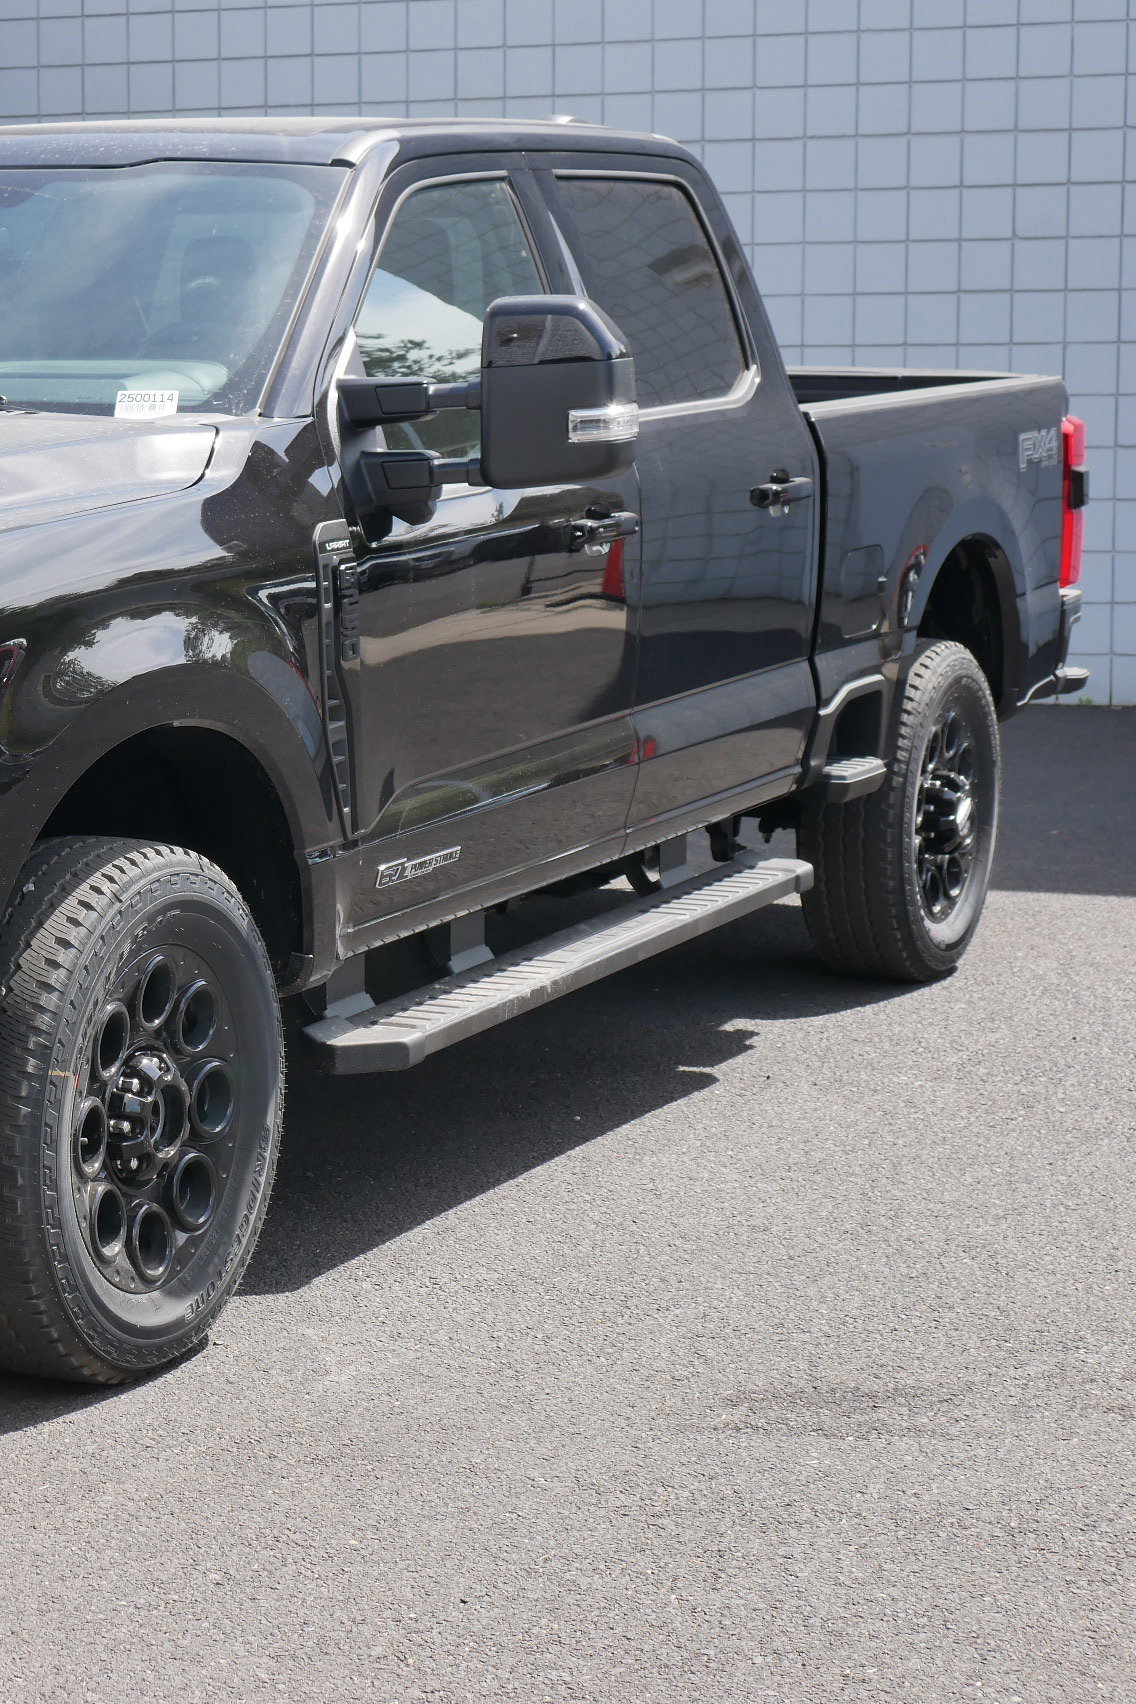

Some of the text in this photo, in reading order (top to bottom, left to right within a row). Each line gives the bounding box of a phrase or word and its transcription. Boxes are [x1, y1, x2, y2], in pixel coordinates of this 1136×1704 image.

[118, 393, 174, 403] 2500114
[1019, 428, 1057, 472] FX4
[325, 539, 350, 550] LARIAT
[184, 1124, 271, 1322] BRIDGESTONE
